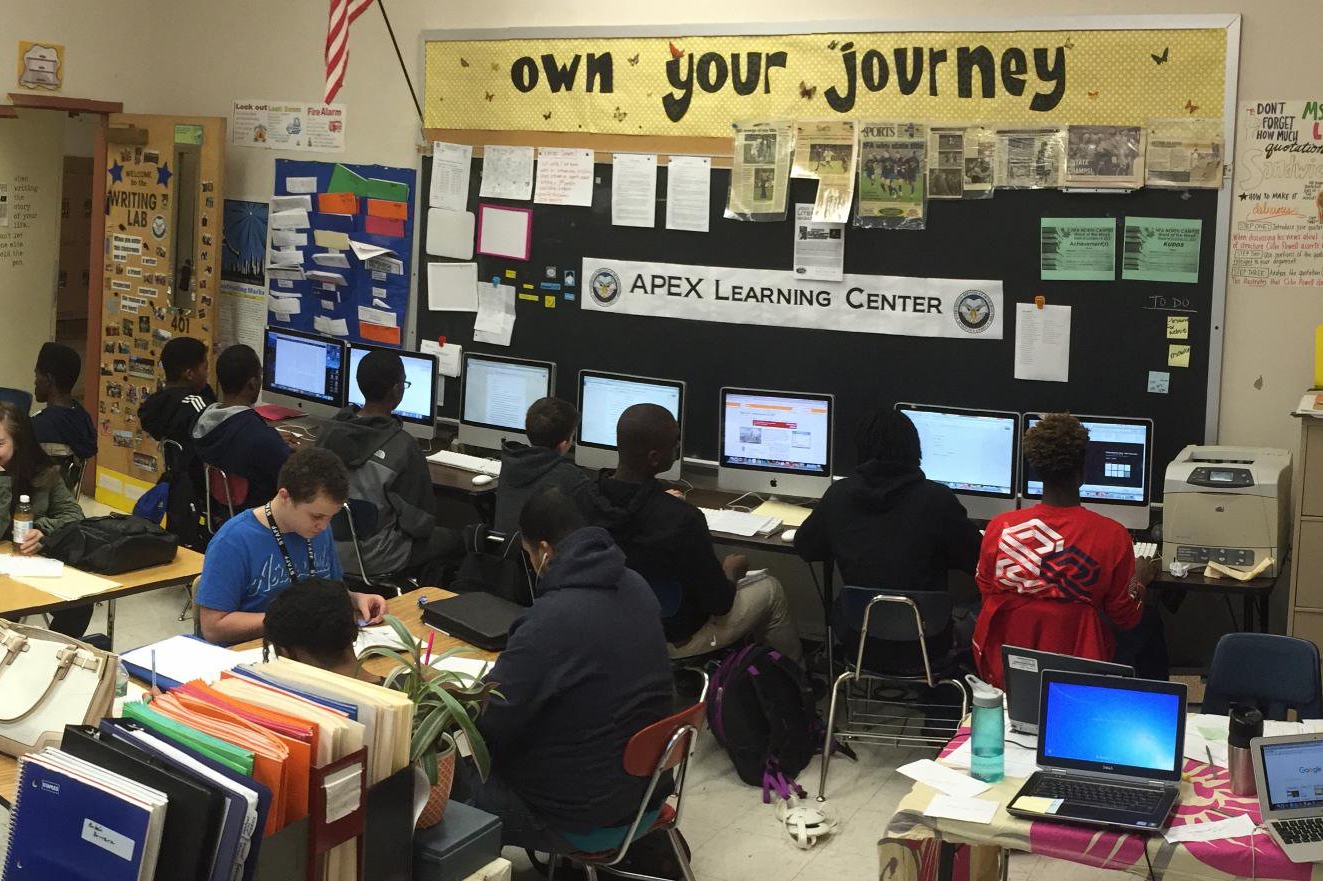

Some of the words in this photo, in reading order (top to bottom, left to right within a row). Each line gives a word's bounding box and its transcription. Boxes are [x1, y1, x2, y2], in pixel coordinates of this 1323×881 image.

[510, 51, 614, 94] own
[661, 51, 788, 123] your
[824, 41, 1067, 113] journey
[236, 103, 253, 112] Lock
[307, 107, 320, 117] Fire
[321, 108, 343, 118] Alarm
[1262, 116, 1296, 130] FORGET
[861, 126, 897, 138] SPORTS
[1256, 130, 1274, 140] HOW
[1276, 130, 1299, 143] MUCH
[126, 170, 153, 178] WELCOME
[14, 184, 39, 193] writing
[138, 179, 148, 187] the
[108, 189, 157, 211] WRITING
[1248, 192, 1261, 201] HOW
[1271, 192, 1291, 201] MAKE
[14, 203, 31, 212] story
[127, 210, 148, 228] LAB
[1282, 242, 1299, 251] Powell
[629, 273, 704, 299] APEX
[171, 315, 190, 333] 401
[271, 525, 284, 547] STAFF
[284, 555, 295, 576] STAFF
